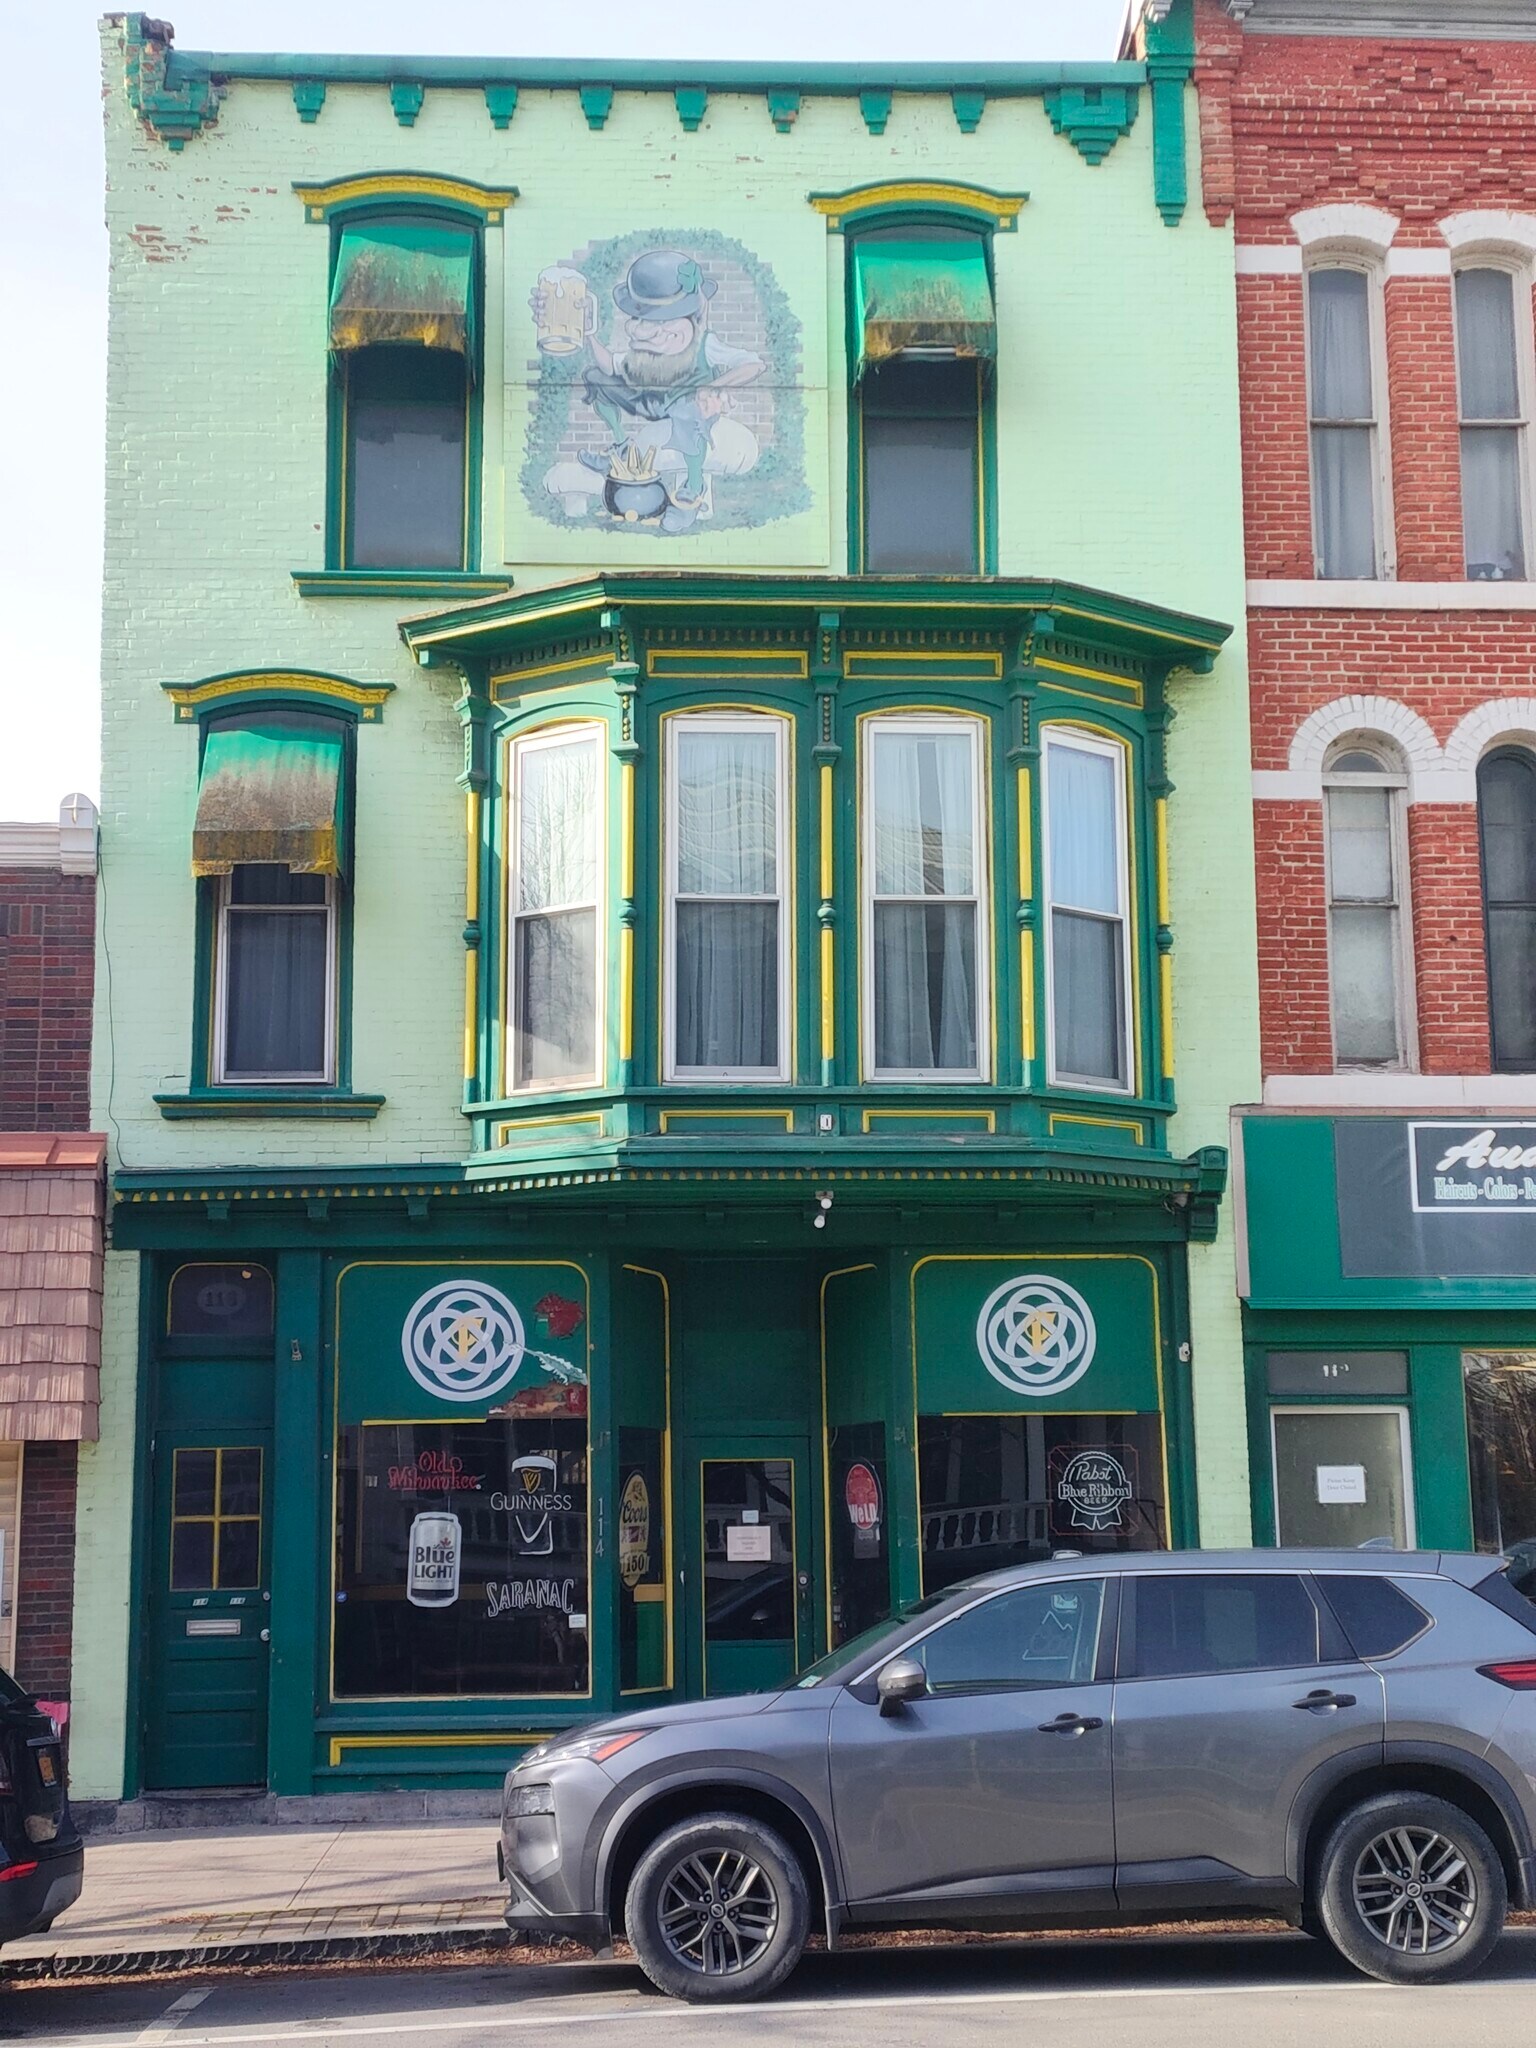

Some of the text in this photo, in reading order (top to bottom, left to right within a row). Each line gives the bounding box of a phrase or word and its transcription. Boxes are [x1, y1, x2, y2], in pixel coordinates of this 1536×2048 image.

[1433, 1176, 1478, 1200] Haircuts
[1483, 1175, 1519, 1200] Colors
[418, 1451, 452, 1474] Old
[1075, 1461, 1113, 1481] Pabst
[1061, 1483, 1130, 1498] Blue Ribbon
[490, 1491, 572, 1511] GUINNESS
[1083, 1497, 1108, 1505] BEER
[622, 1500, 648, 1524] Coors
[415, 1546, 455, 1564] Blue
[626, 1553, 645, 1573] 150
[414, 1564, 454, 1579] LIGHT
[486, 1579, 575, 1617] SARANAC
